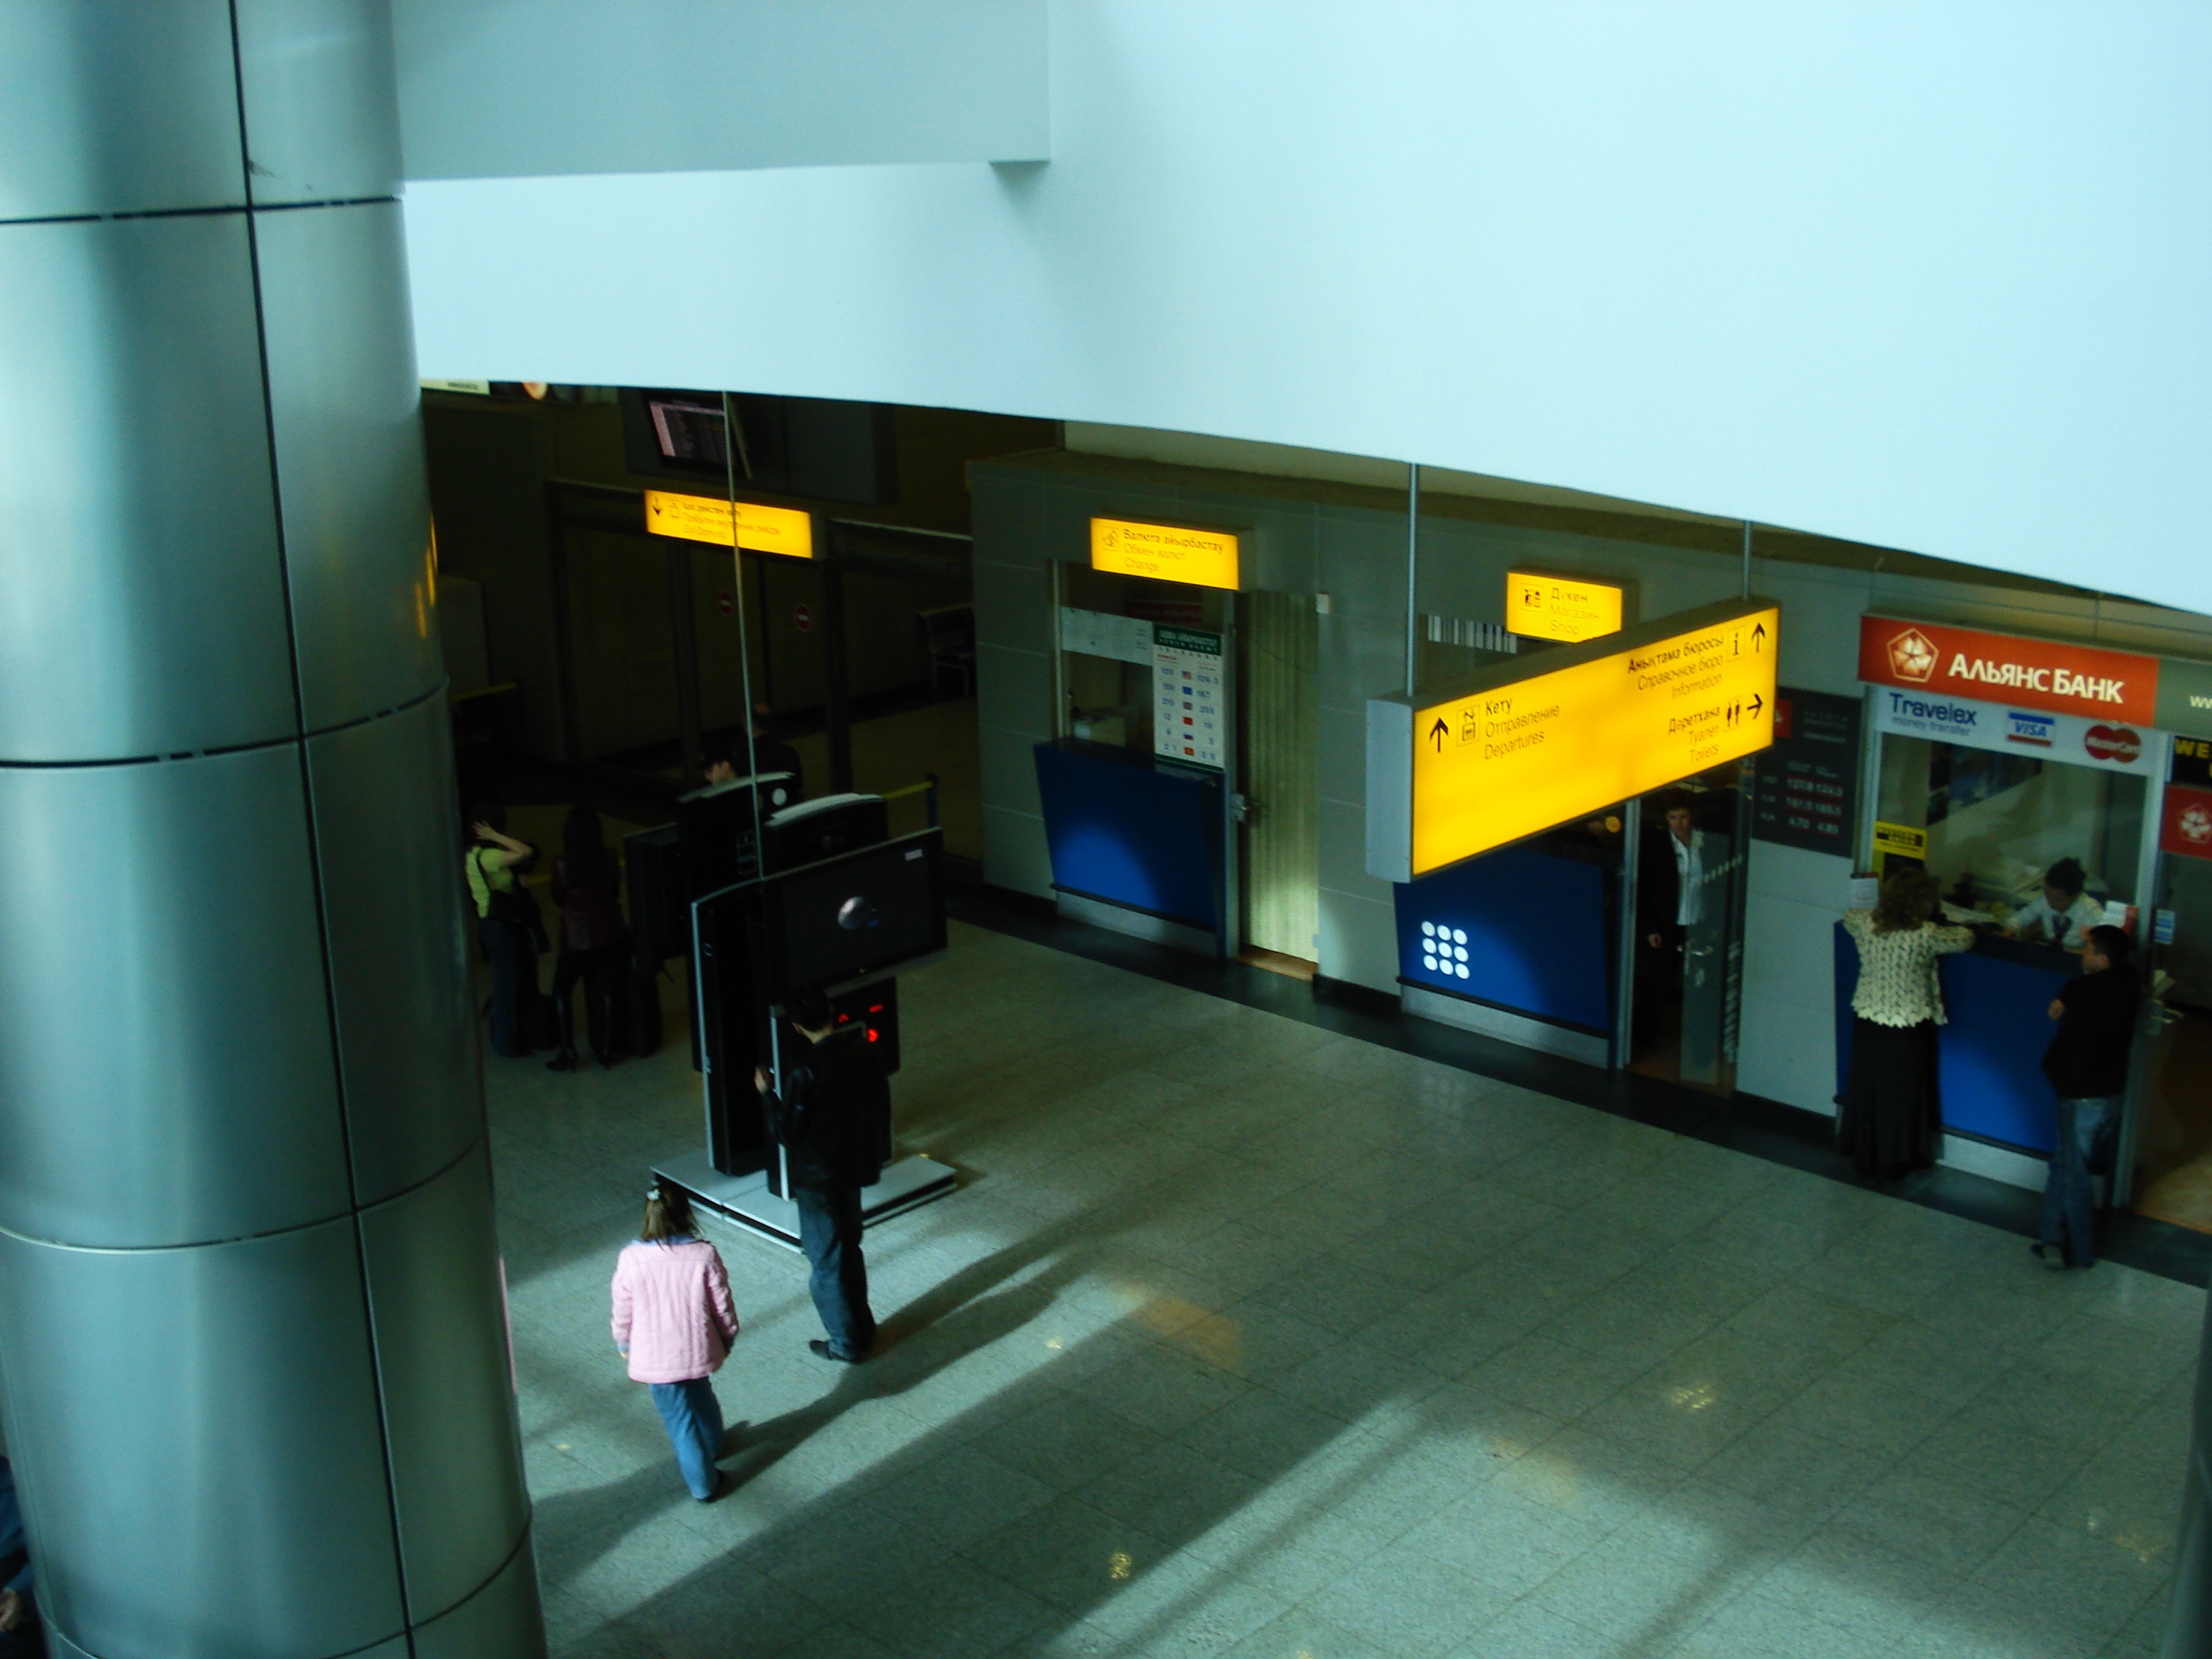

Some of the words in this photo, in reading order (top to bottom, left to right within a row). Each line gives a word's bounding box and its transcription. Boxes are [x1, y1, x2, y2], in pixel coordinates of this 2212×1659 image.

[1125, 557, 1159, 573] Change
[1550, 619, 1580, 637] Shop
[1637, 663, 1697, 691] Справочное
[1699, 655, 1723, 671] бюро
[1672, 674, 1723, 698] Information
[1485, 698, 1513, 716] Кету
[1889, 692, 1977, 726] Travelex
[1485, 705, 1560, 737] Отправление
[2015, 721, 2047, 737] VISA
[1485, 731, 1545, 760] Departures
[1689, 744, 1719, 763] Toilets
[2175, 737, 2212, 759] WE
